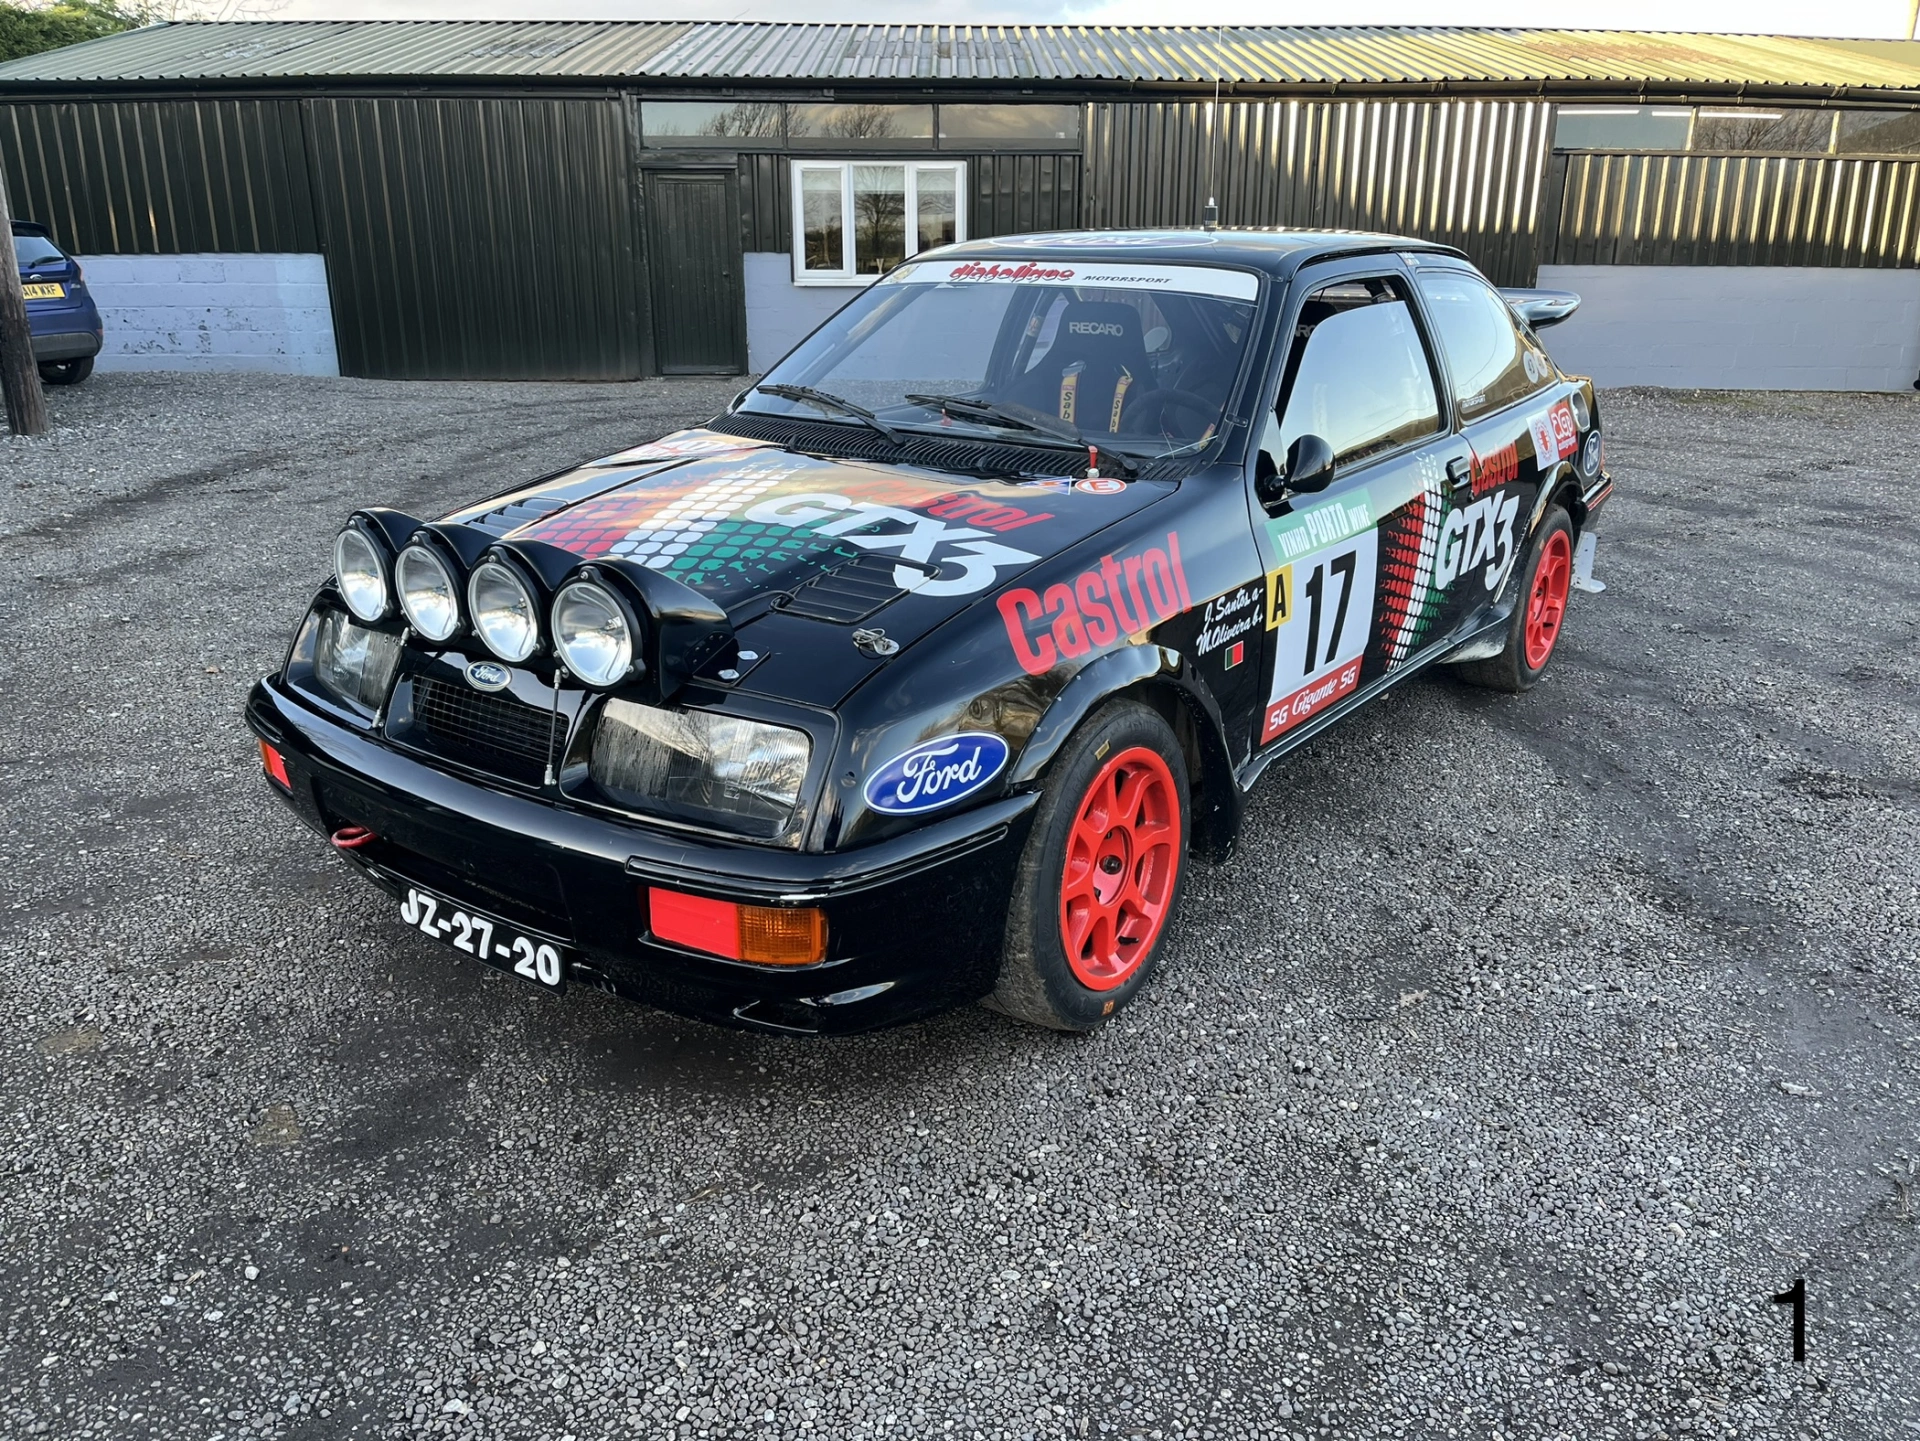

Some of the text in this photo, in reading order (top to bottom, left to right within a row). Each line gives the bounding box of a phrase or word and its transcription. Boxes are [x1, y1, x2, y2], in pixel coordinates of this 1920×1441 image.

[1081, 274, 1173, 285] MOTORSPORT
[1069, 321, 1124, 337] RECARO
[1089, 480, 1114, 491] E
[1469, 439, 1519, 496] Castrol
[842, 480, 1056, 531] Castrol
[1277, 502, 1371, 558] VINHO PORTO WINE
[744, 493, 1042, 597] GTX3
[1435, 489, 1520, 590] GTX3
[996, 531, 1192, 676] Castrol
[1271, 573, 1287, 623] A
[1303, 550, 1357, 676] 17
[475, 665, 502, 683] Ford
[1269, 665, 1357, 732] SG Gigante SG
[896, 743, 982, 803] Ford
[400, 888, 562, 987] JZ-27-20
